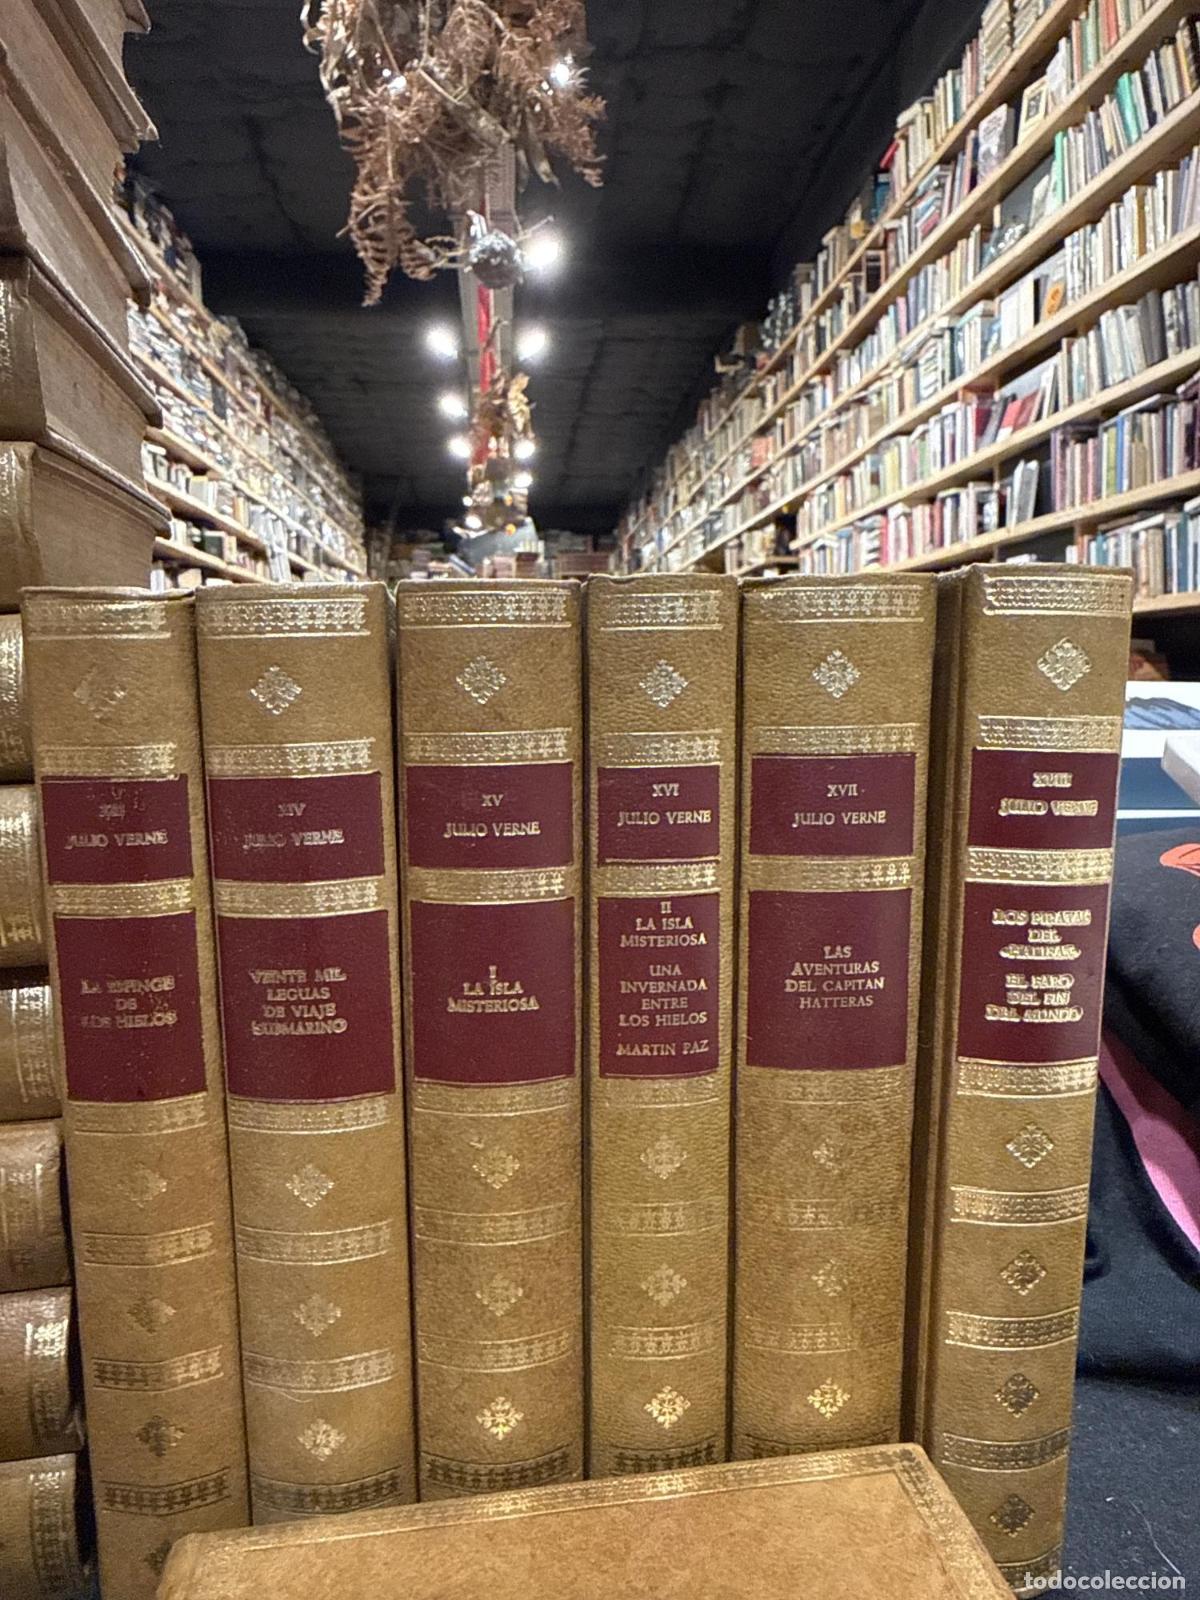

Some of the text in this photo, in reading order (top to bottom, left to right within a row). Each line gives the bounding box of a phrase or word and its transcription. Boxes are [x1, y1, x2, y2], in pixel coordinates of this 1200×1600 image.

[652, 783, 680, 797] XVI
[827, 783, 859, 797] XVII
[482, 794, 504, 807] XV
[617, 809, 712, 827] JULIO VERNE
[792, 810, 887, 828] JULIO VERNE
[114, 829, 168, 846] VERNE
[290, 829, 345, 846] VERNE
[444, 821, 540, 838] JULIO VERNE
[660, 901, 672, 914] II
[636, 916, 694, 931] LA ISLA
[992, 908, 1029, 926] LOS
[620, 932, 708, 948] MISTERIOSA
[823, 945, 852, 959] LAS
[248, 967, 347, 984] VEINTE MIL
[649, 964, 682, 977] UNA
[791, 961, 880, 976] AVENTURAS
[463, 980, 524, 995] LA ISLA
[620, 978, 708, 994] INVERNADA
[784, 976, 885, 993] DEL CAPITAN
[267, 987, 331, 1001] LEGUAS
[447, 995, 540, 1013] MISTERIOSA
[641, 997, 688, 1010] ENTRE
[799, 995, 874, 1010] HATTERAS
[115, 1010, 178, 1029] HIELOS
[263, 1003, 336, 1020] DE VIAJE
[619, 1011, 708, 1027] LOS HIELOS
[251, 1018, 348, 1036] SUBMARINO
[616, 1039, 710, 1056] MARTIN PAZ
